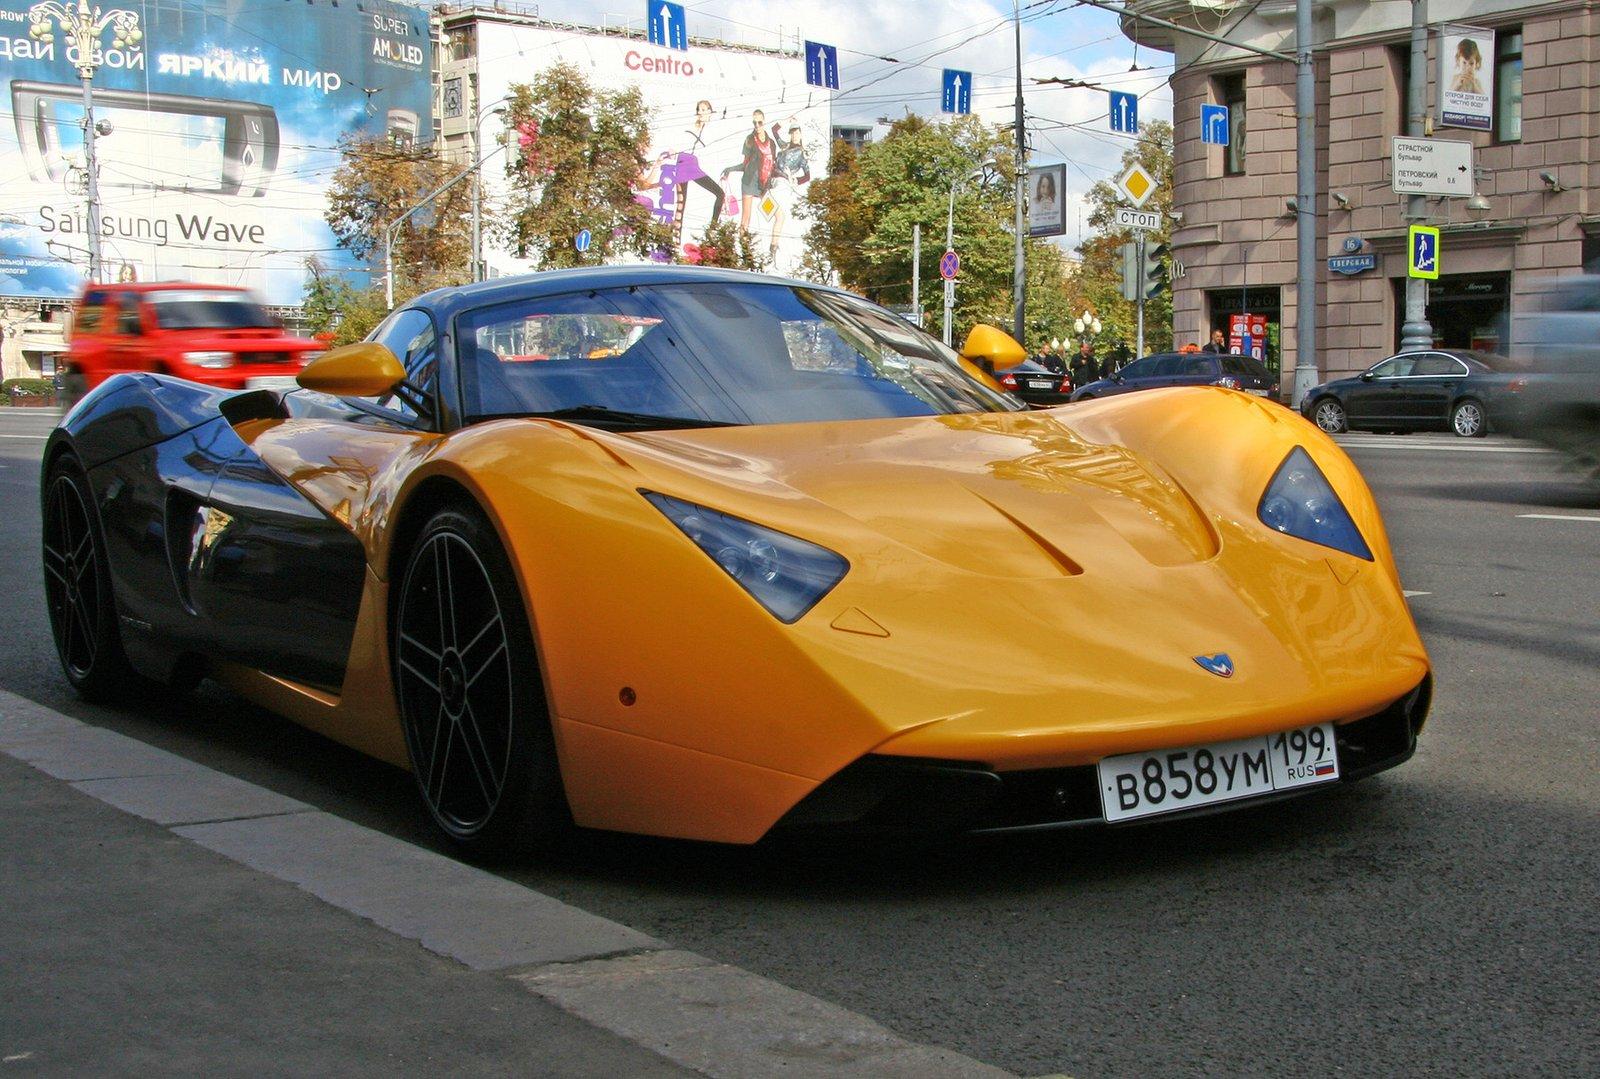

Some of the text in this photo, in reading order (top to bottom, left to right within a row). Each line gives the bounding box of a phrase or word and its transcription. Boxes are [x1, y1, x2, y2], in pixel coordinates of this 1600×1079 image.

[373, 14, 409, 37] SUPER
[373, 37, 423, 65] AMOLED
[282, 67, 342, 95] мир
[1397, 144, 1433, 153] СТРАСТНОЙ
[1398, 170, 1438, 179] ПЕТРОВСКИЙ
[1121, 212, 1155, 226] СТОП
[176, 213, 265, 244] Wave
[1347, 239, 1356, 249] 16
[1332, 258, 1370, 267] ТВЕРСКАЯ
[1116, 726, 1326, 811] В858УМ 199
[1287, 763, 1315, 781] RUS
